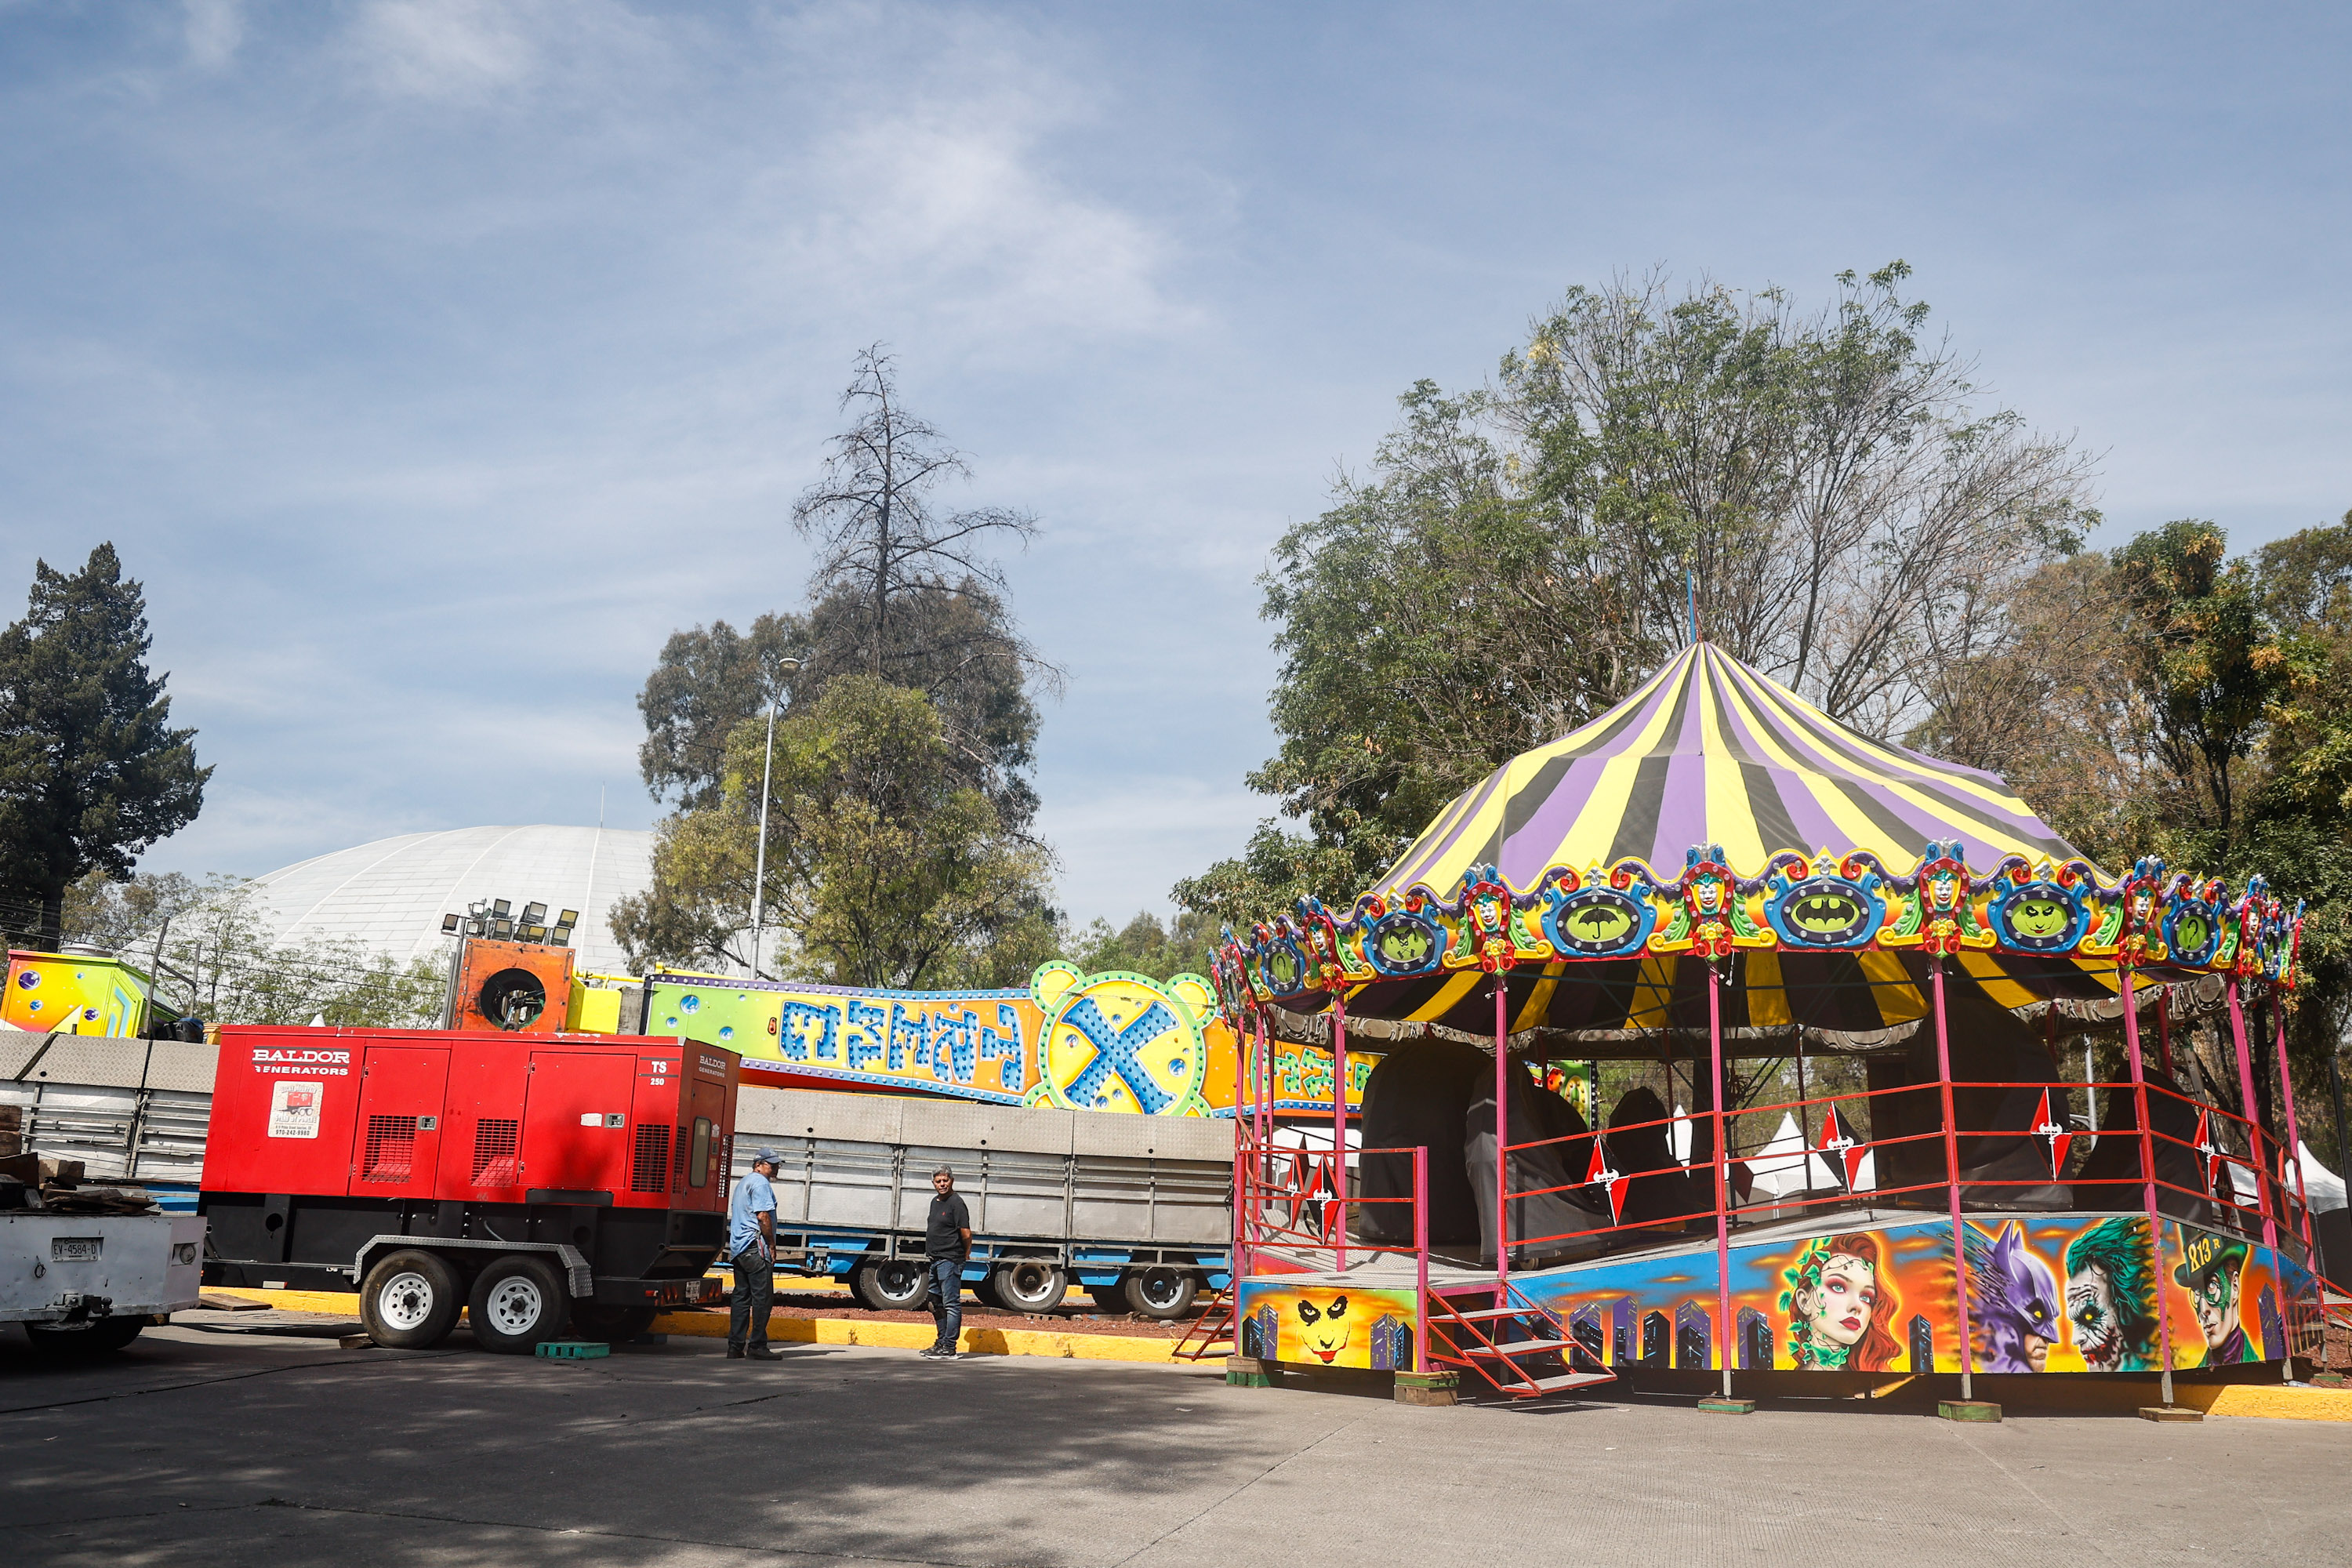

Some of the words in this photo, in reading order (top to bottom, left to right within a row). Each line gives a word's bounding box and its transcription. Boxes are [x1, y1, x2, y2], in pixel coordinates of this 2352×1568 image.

[252, 1049, 350, 1064] BALDOR
[699, 1055, 726, 1070] BALDOR
[651, 1061, 667, 1073] TS
[699, 1066, 725, 1078] GENERATORS
[53, 1244, 96, 1254] EV-4584-D
